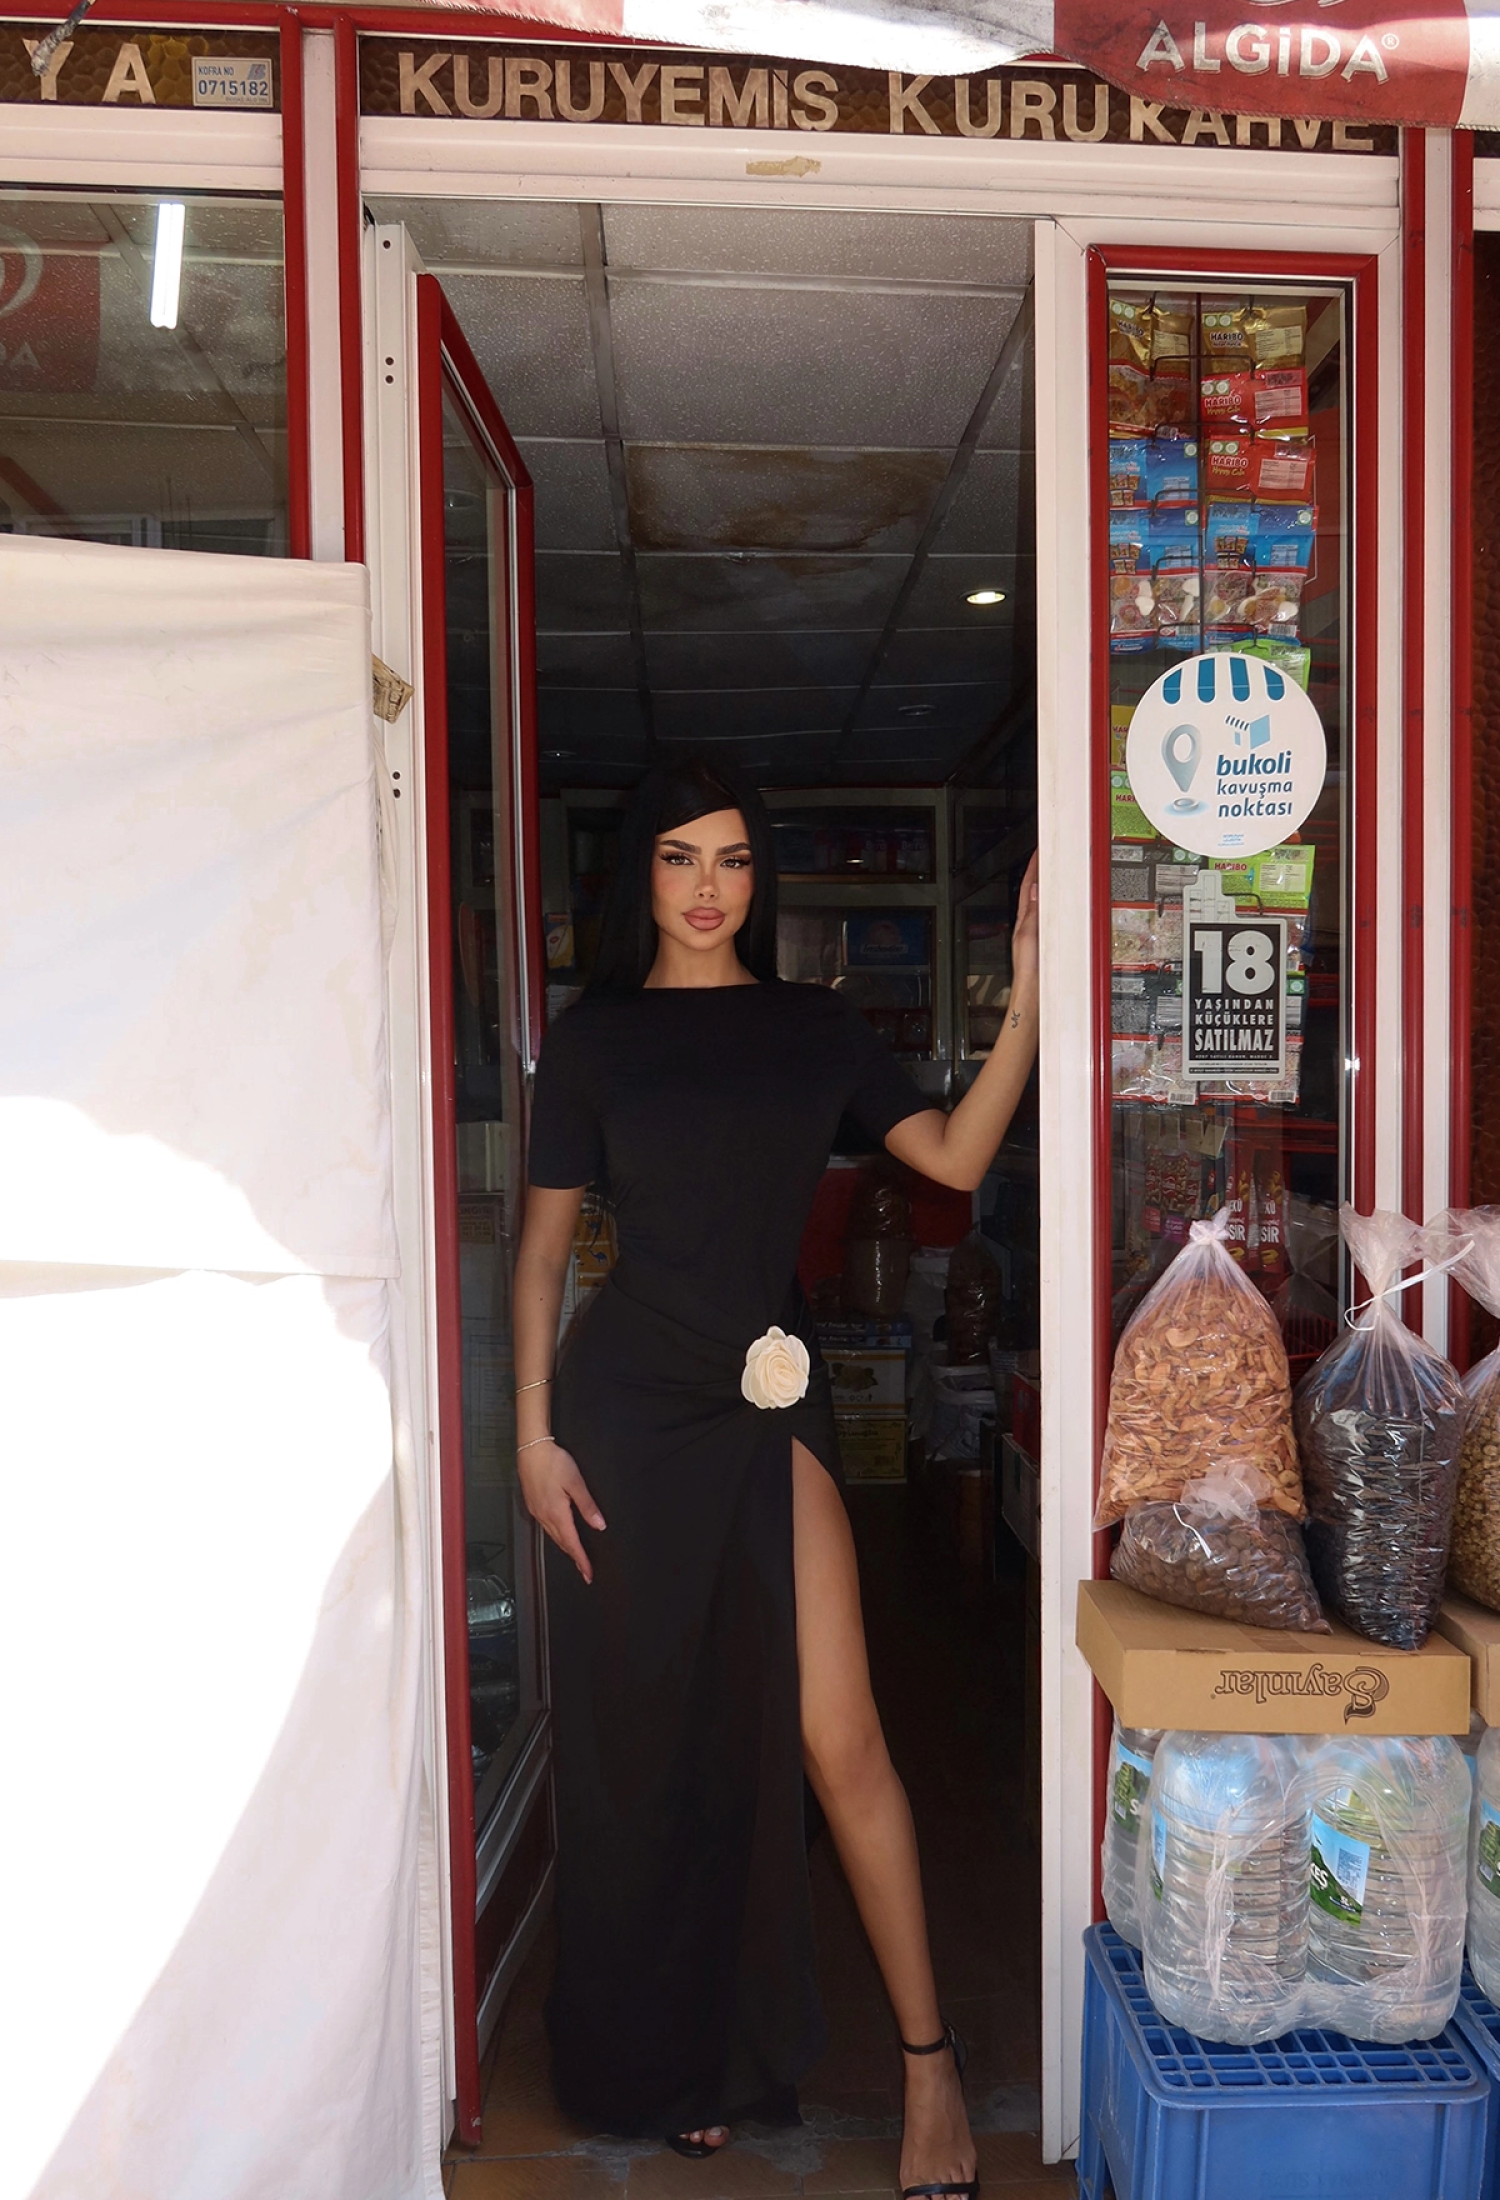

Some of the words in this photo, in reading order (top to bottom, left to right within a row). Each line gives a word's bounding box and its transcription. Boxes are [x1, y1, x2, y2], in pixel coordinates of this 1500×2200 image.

[198, 66, 221, 76] KOFRA
[223, 67, 234, 76] NO
[198, 80, 268, 96] 0715182
[1210, 332, 1244, 341] HARIBO
[1205, 395, 1241, 407] HARIBO
[1211, 455, 1248, 468] HARIBO
[1216, 750, 1291, 776] bukoli
[1217, 778, 1293, 799] kavuşma
[1218, 797, 1292, 818] noktası
[1214, 862, 1247, 871] HARIBO
[1194, 930, 1275, 995] 18
[1194, 999, 1274, 1011] YAŞINDAN
[1195, 1011, 1274, 1027] KÜÇÜKLERE
[1194, 1029, 1274, 1051] SATILMAZ
